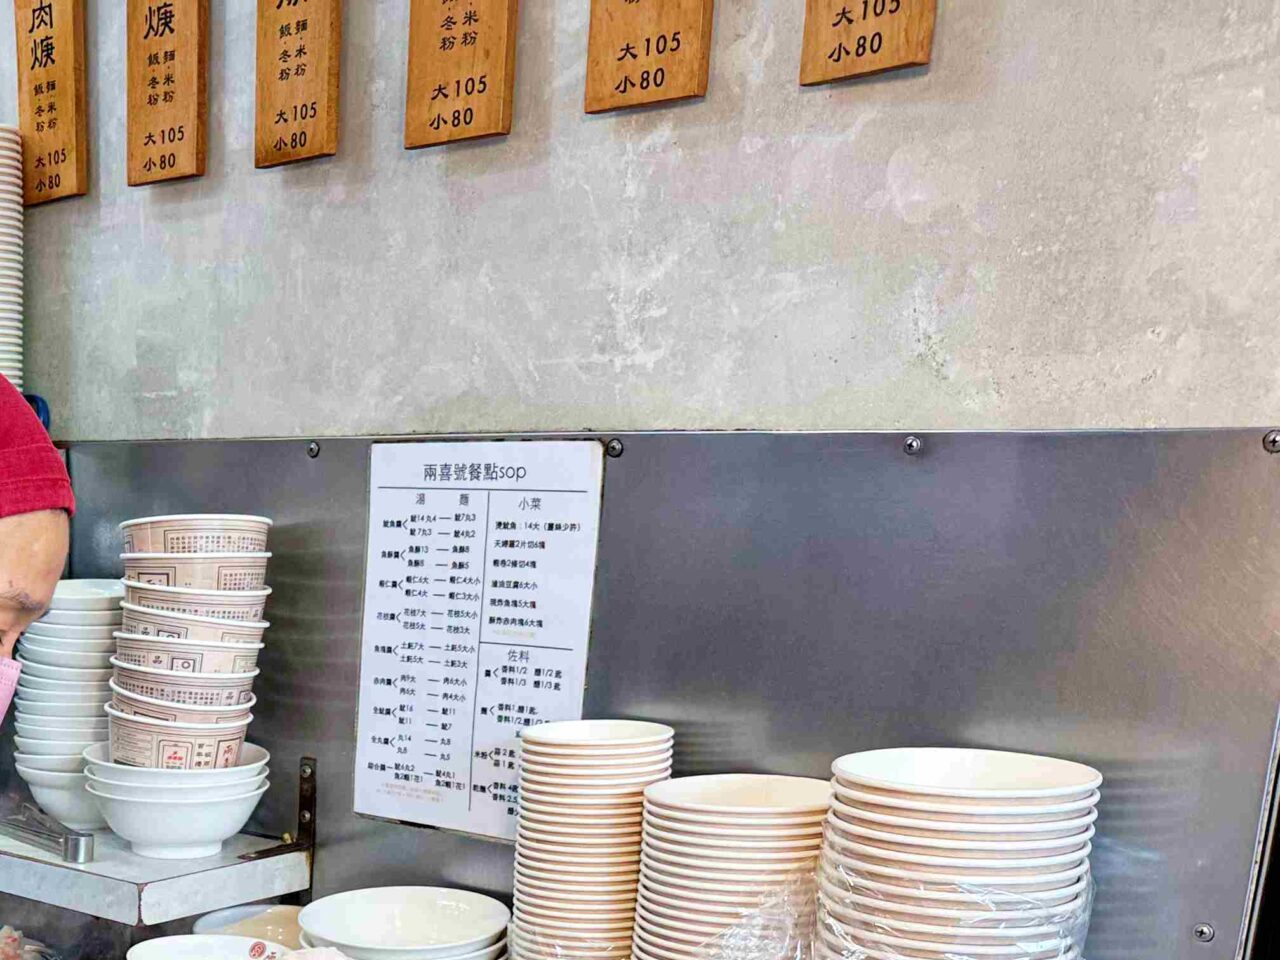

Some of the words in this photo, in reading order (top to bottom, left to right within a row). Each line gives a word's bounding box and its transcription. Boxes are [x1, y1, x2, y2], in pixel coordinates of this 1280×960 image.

[423, 462, 527, 482] 兩喜號餐點sop
[518, 496, 542, 511] 小菜
[507, 649, 530, 663] 佐料
